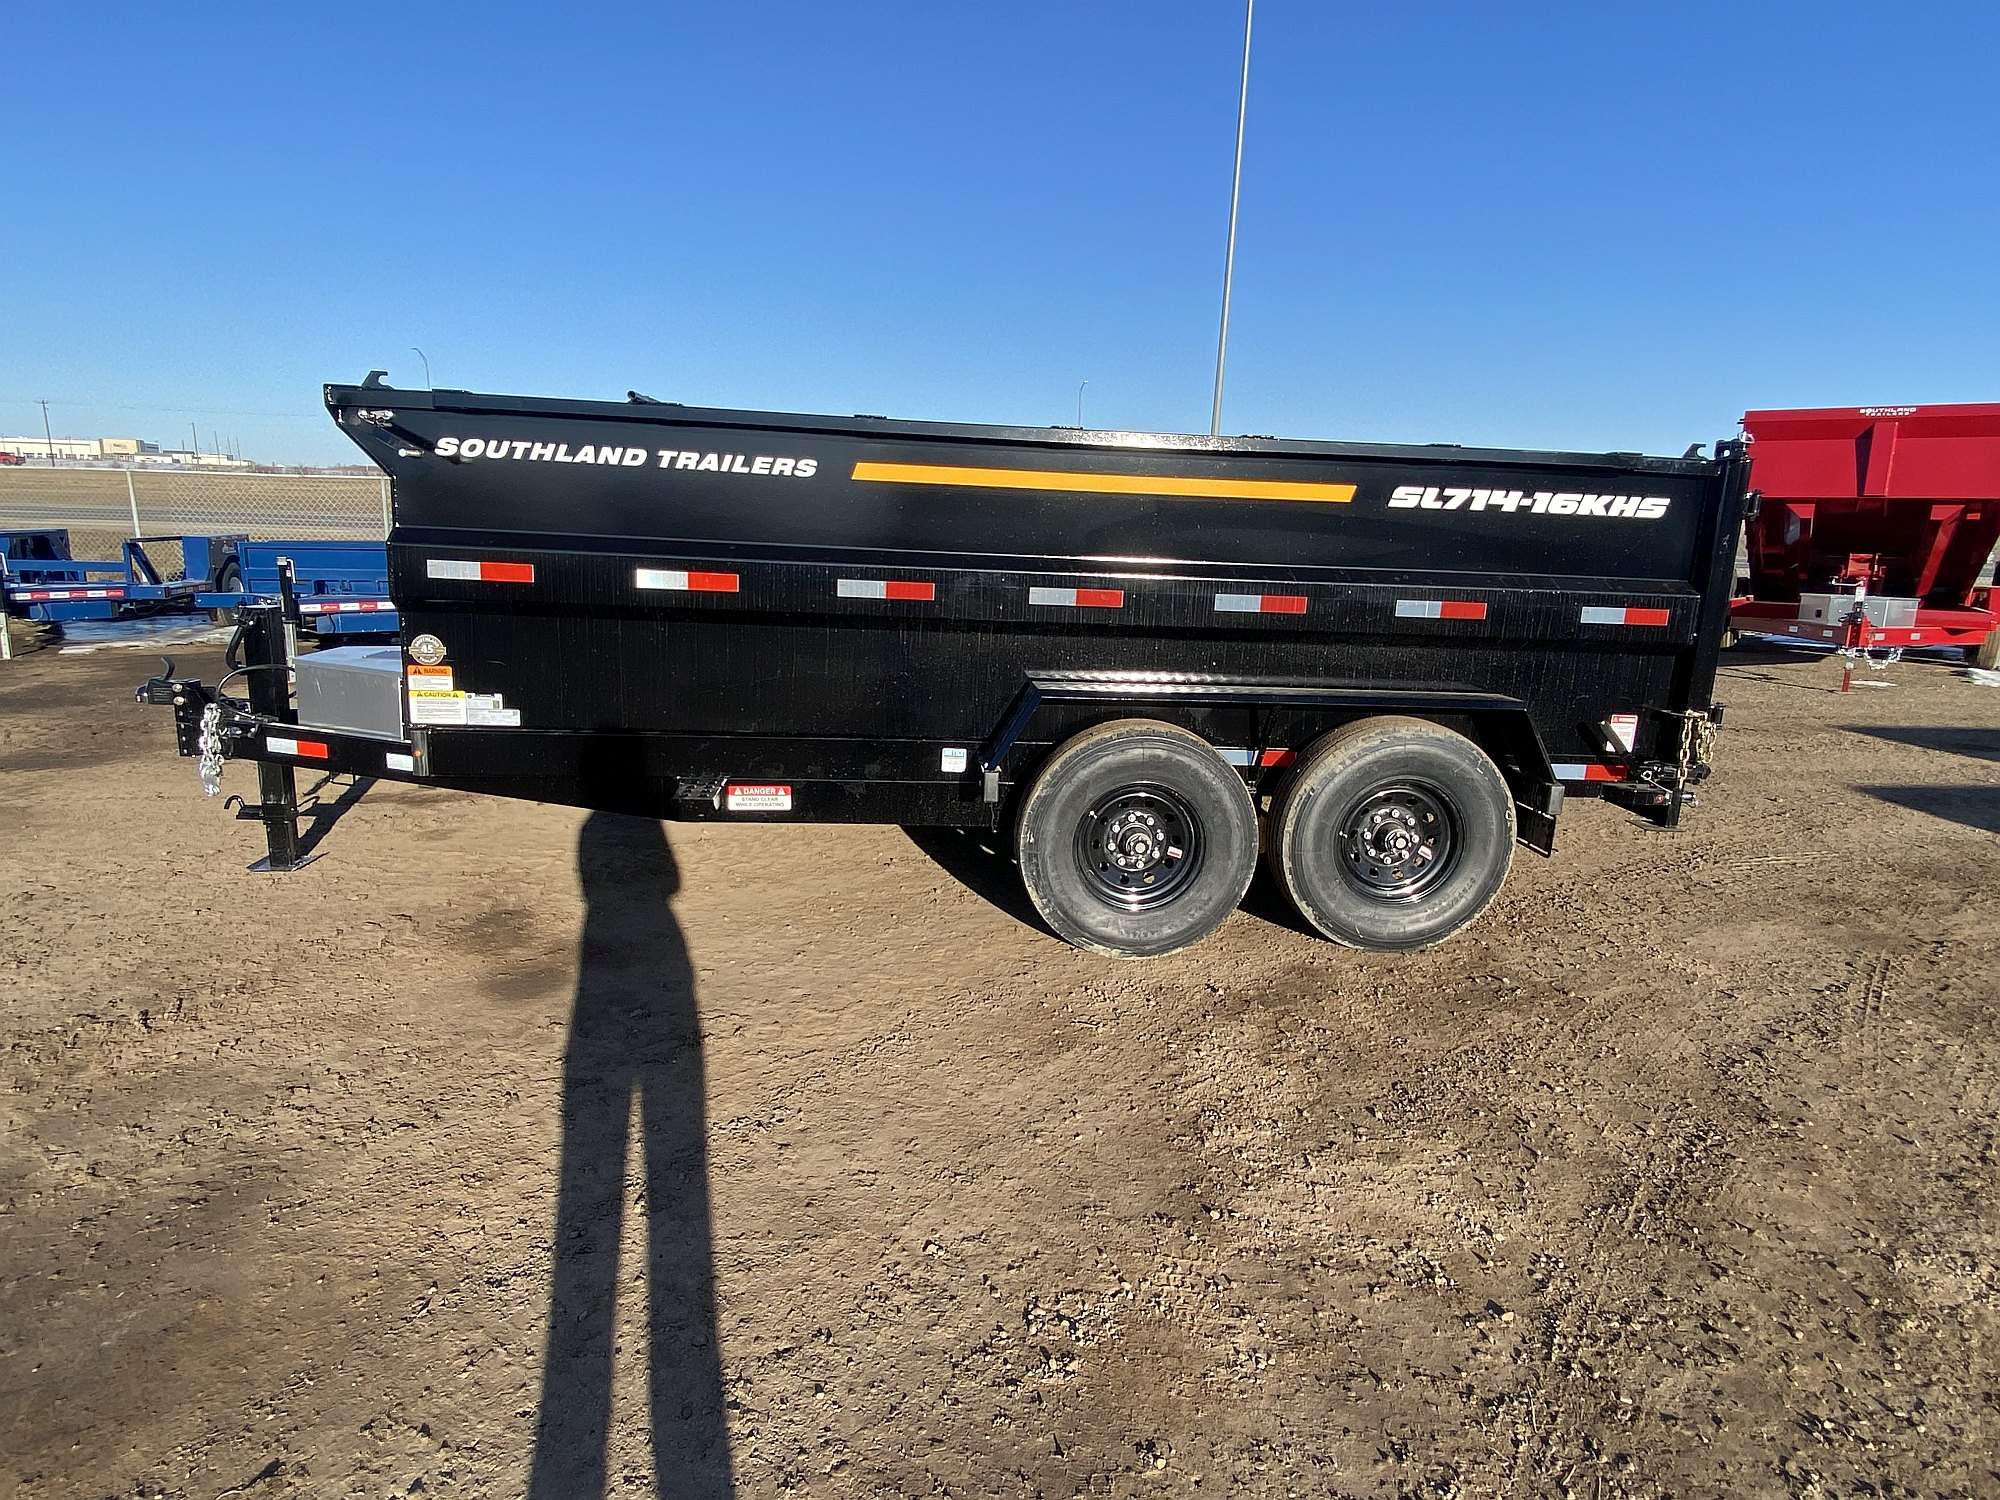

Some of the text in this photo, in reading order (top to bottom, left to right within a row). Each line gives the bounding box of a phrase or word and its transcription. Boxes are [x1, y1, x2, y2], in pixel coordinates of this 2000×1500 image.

[433, 437, 818, 478] SOUTHLAND TRAILERS
[1387, 485, 1671, 519] SL714-16KHS
[743, 787, 776, 795] DANGER
